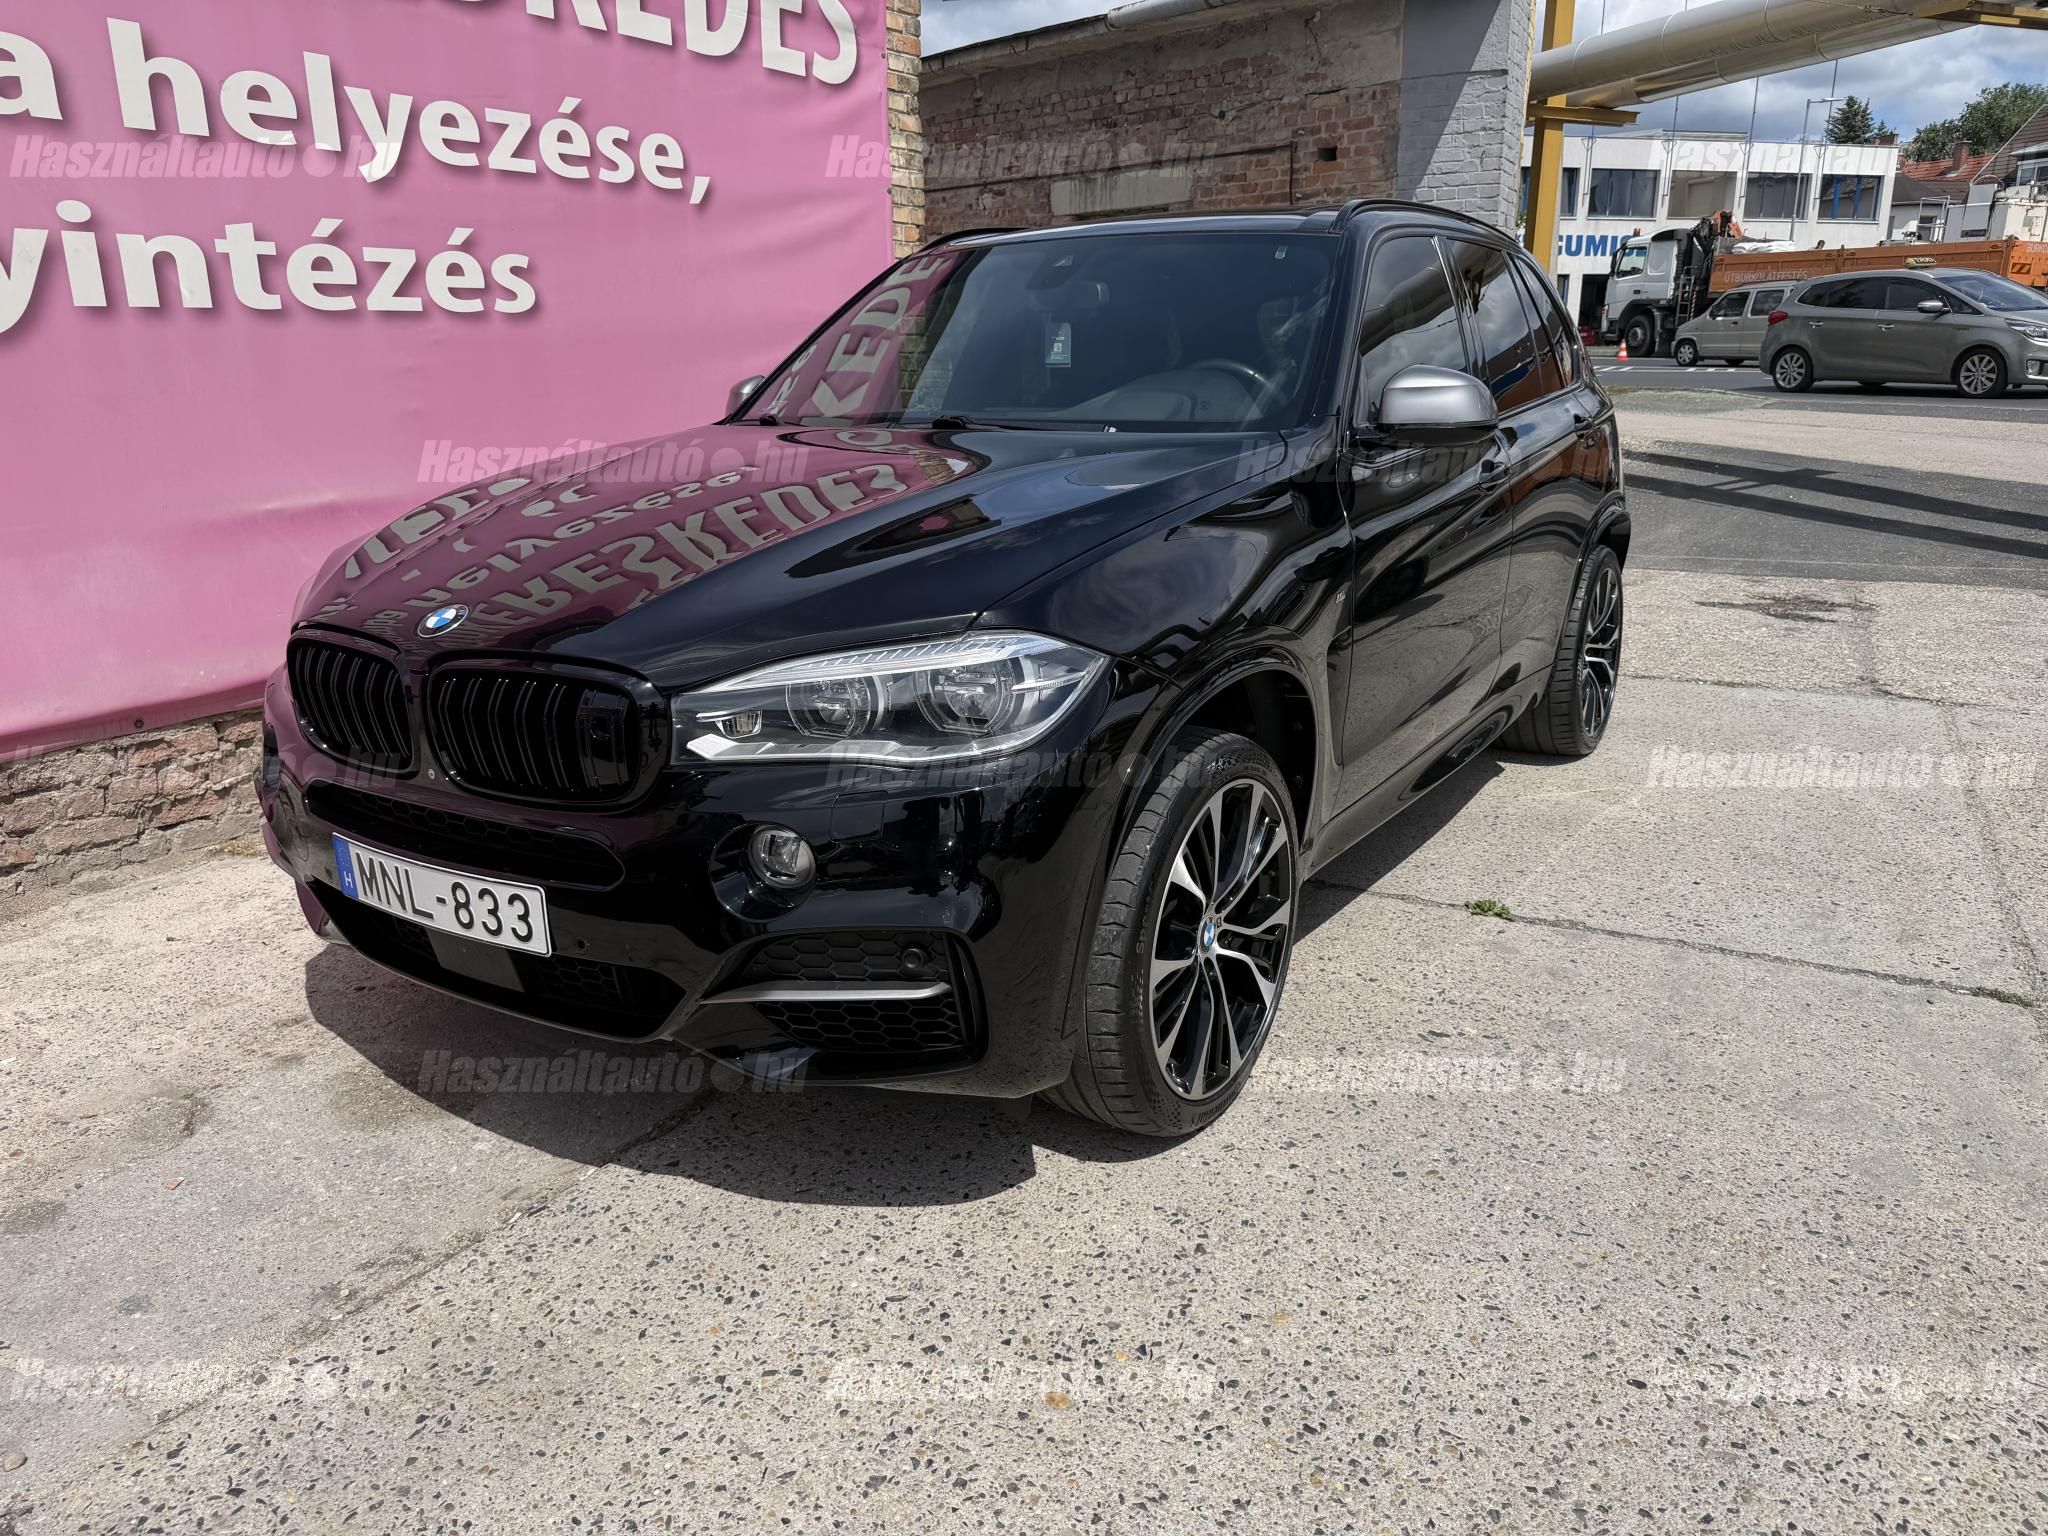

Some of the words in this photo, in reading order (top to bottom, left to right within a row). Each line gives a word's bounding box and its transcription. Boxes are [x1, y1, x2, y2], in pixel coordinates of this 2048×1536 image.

[107, 17, 711, 204] helyezése,
[343, 871, 354, 889] H
[356, 851, 534, 943] MNL-833
